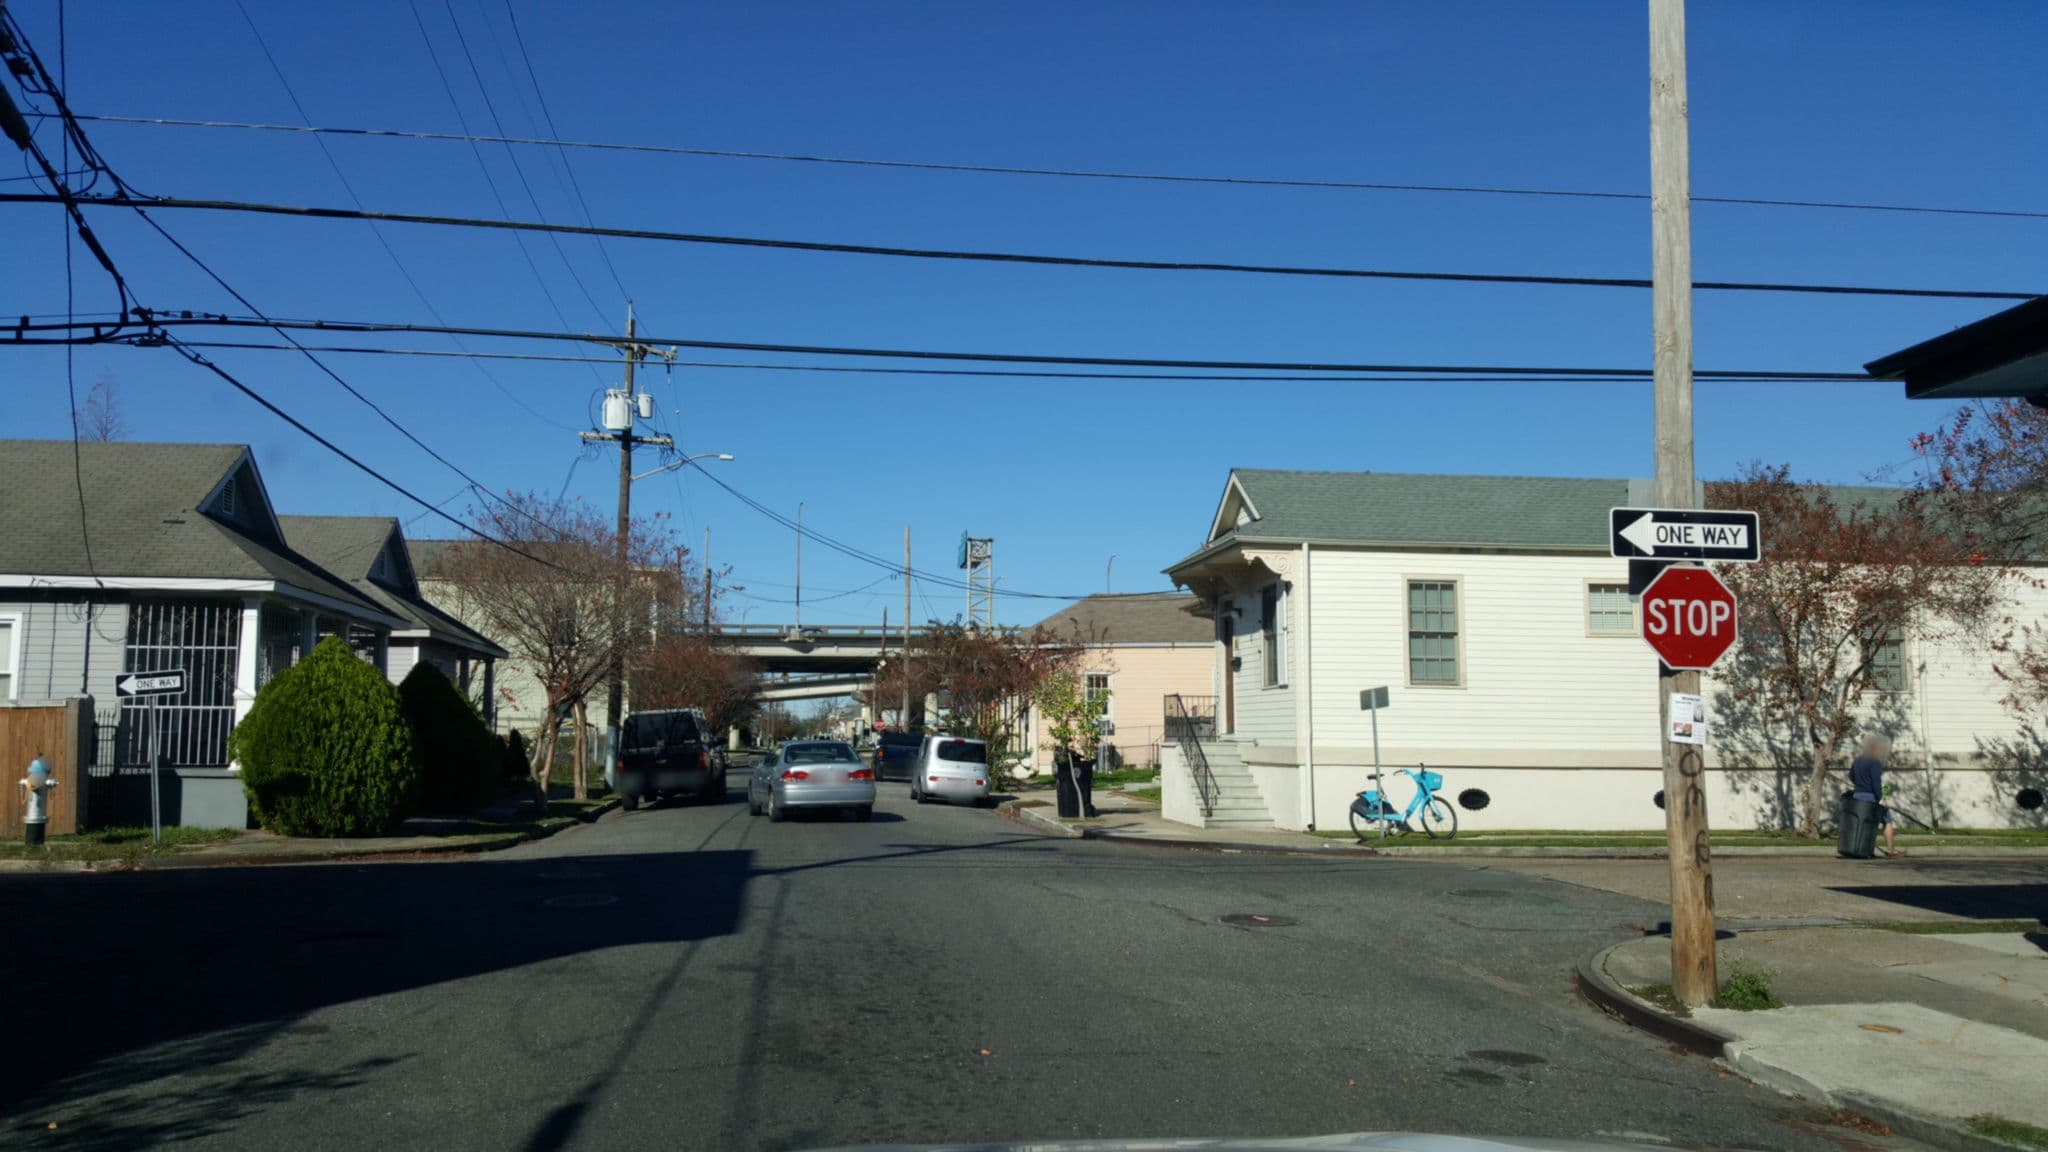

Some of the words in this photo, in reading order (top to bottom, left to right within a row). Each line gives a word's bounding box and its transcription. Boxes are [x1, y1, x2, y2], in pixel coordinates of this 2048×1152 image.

[1656, 525, 1694, 544] ONE
[1702, 527, 1741, 545] WAY
[1648, 598, 1730, 636] STOP
[136, 679, 156, 689] ONE
[159, 678, 177, 687] WAY
